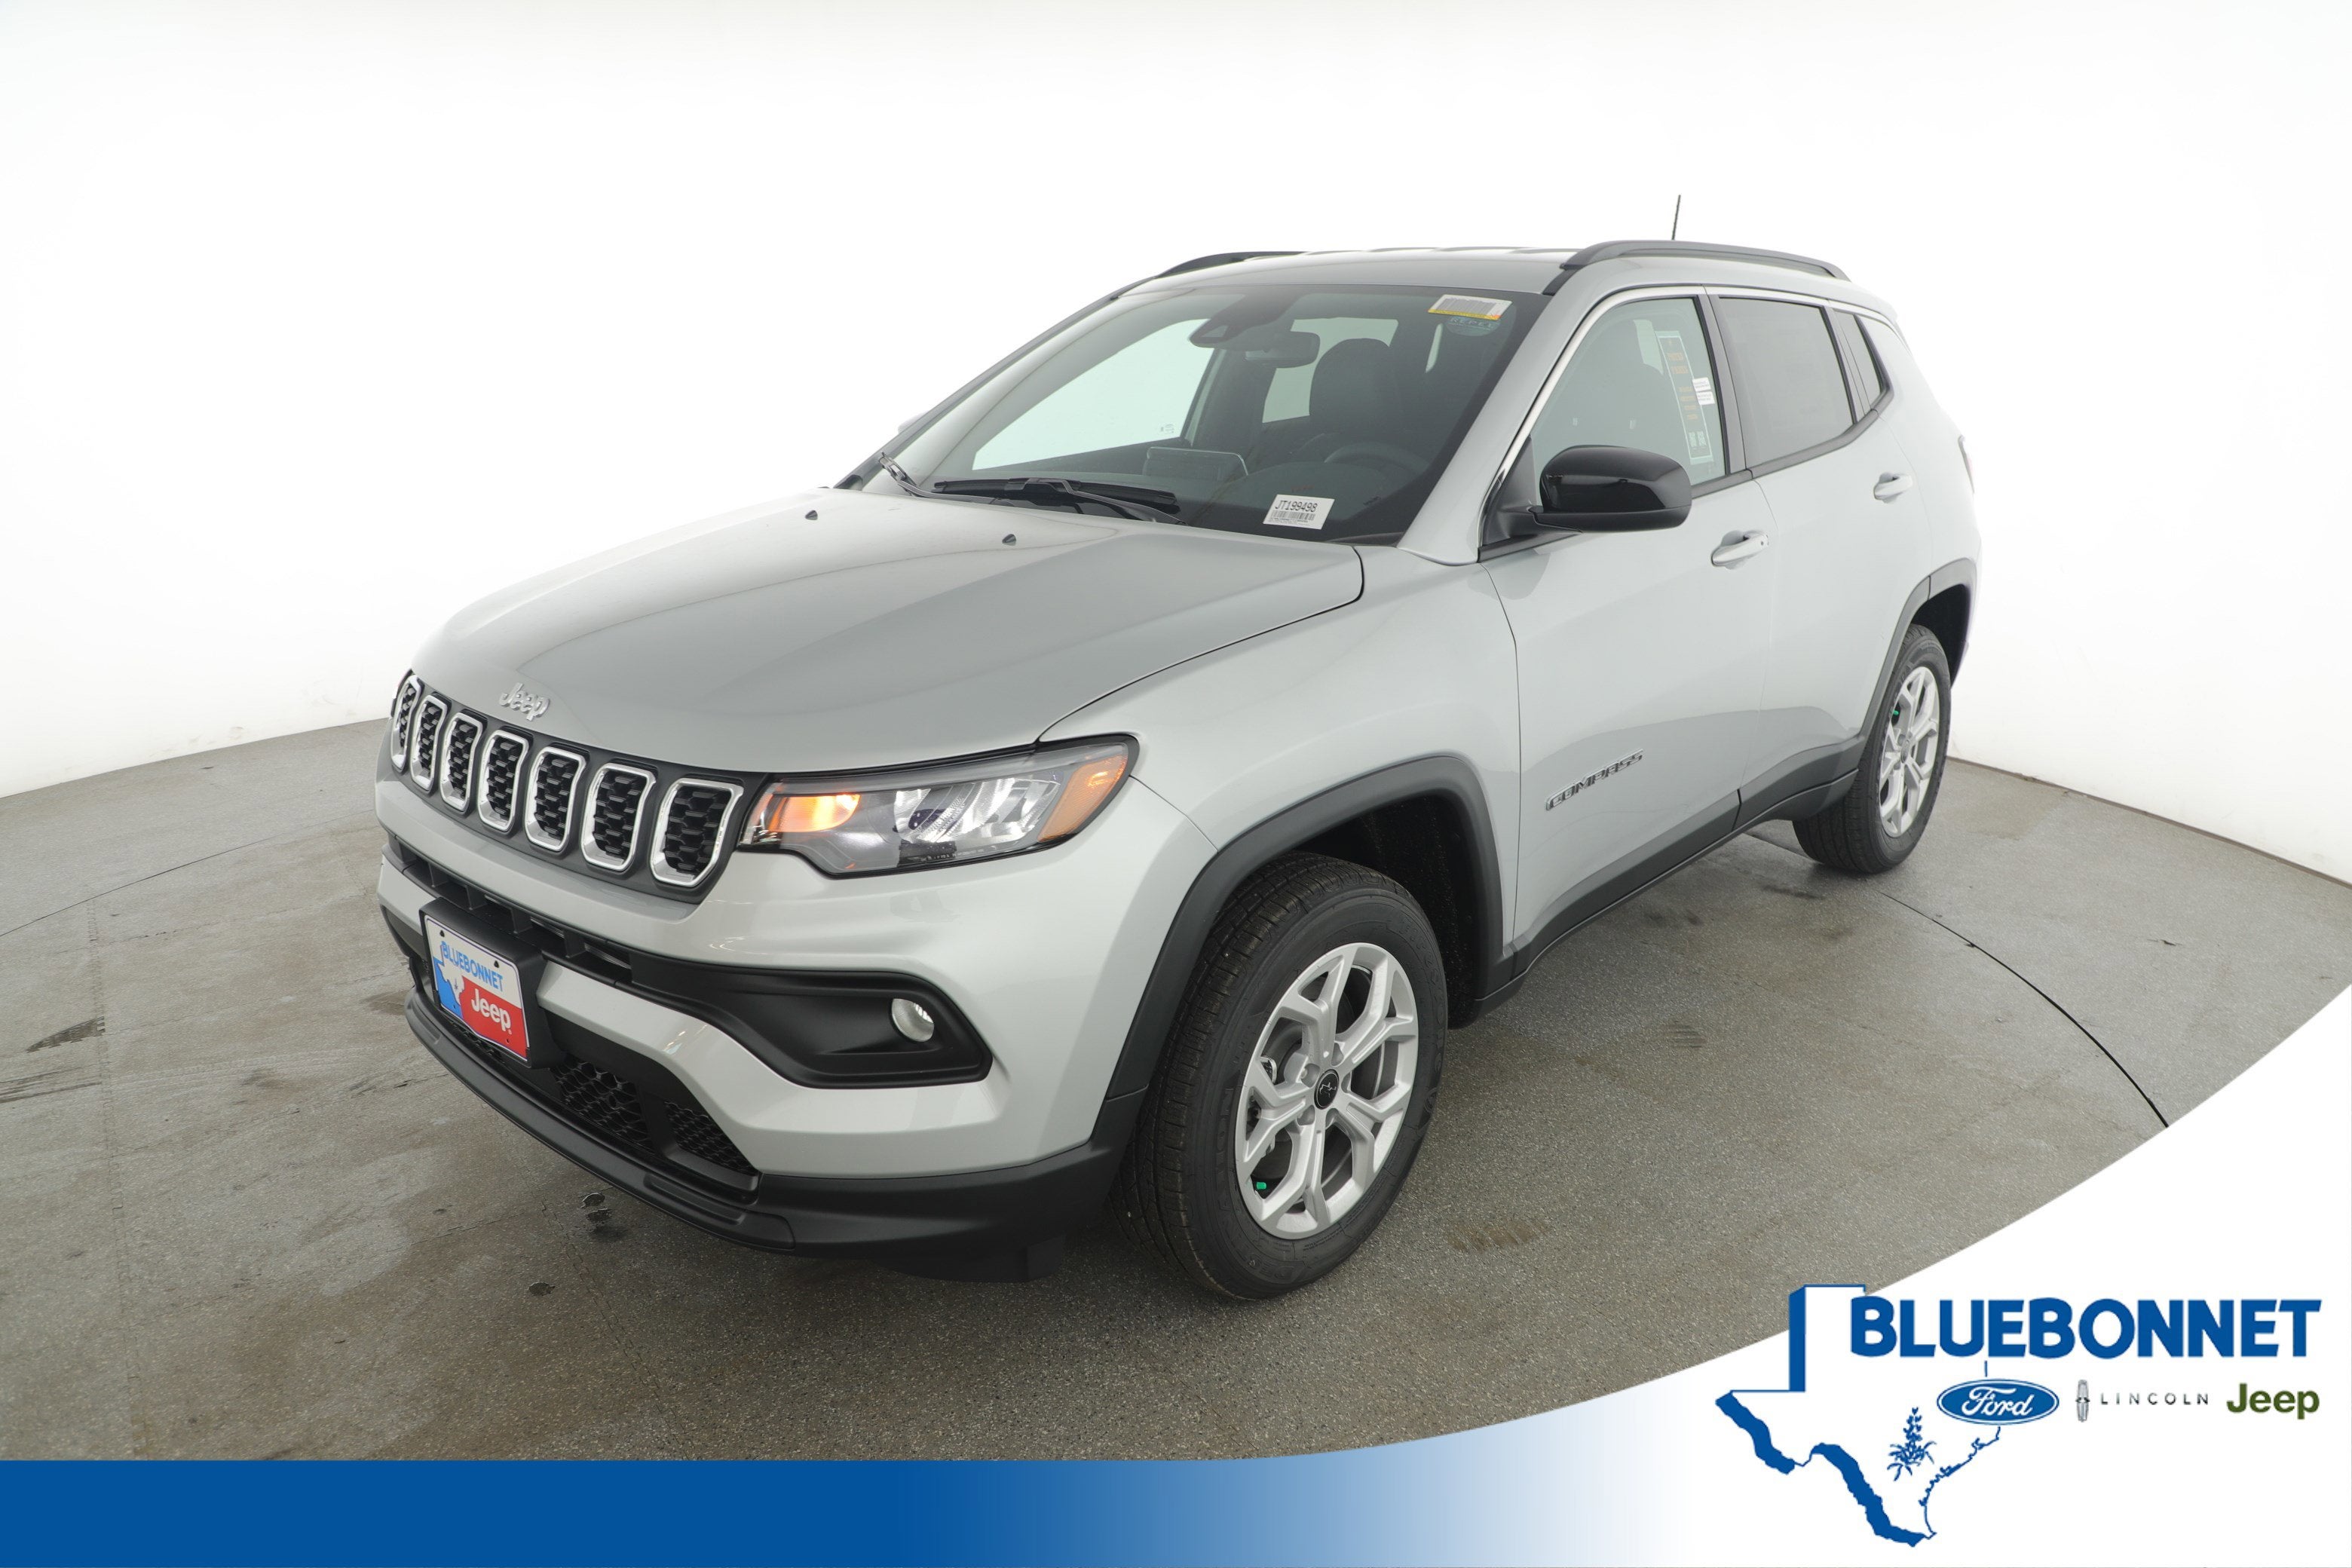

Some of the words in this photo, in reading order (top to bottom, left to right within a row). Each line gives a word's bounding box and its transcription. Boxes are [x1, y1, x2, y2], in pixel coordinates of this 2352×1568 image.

[1275, 501, 1318, 513] JT199498
[499, 682, 550, 721] Jeep
[1546, 749, 1643, 810] COMPASS
[442, 941, 504, 992] BLUEBONNET
[471, 988, 511, 1031] Jeep
